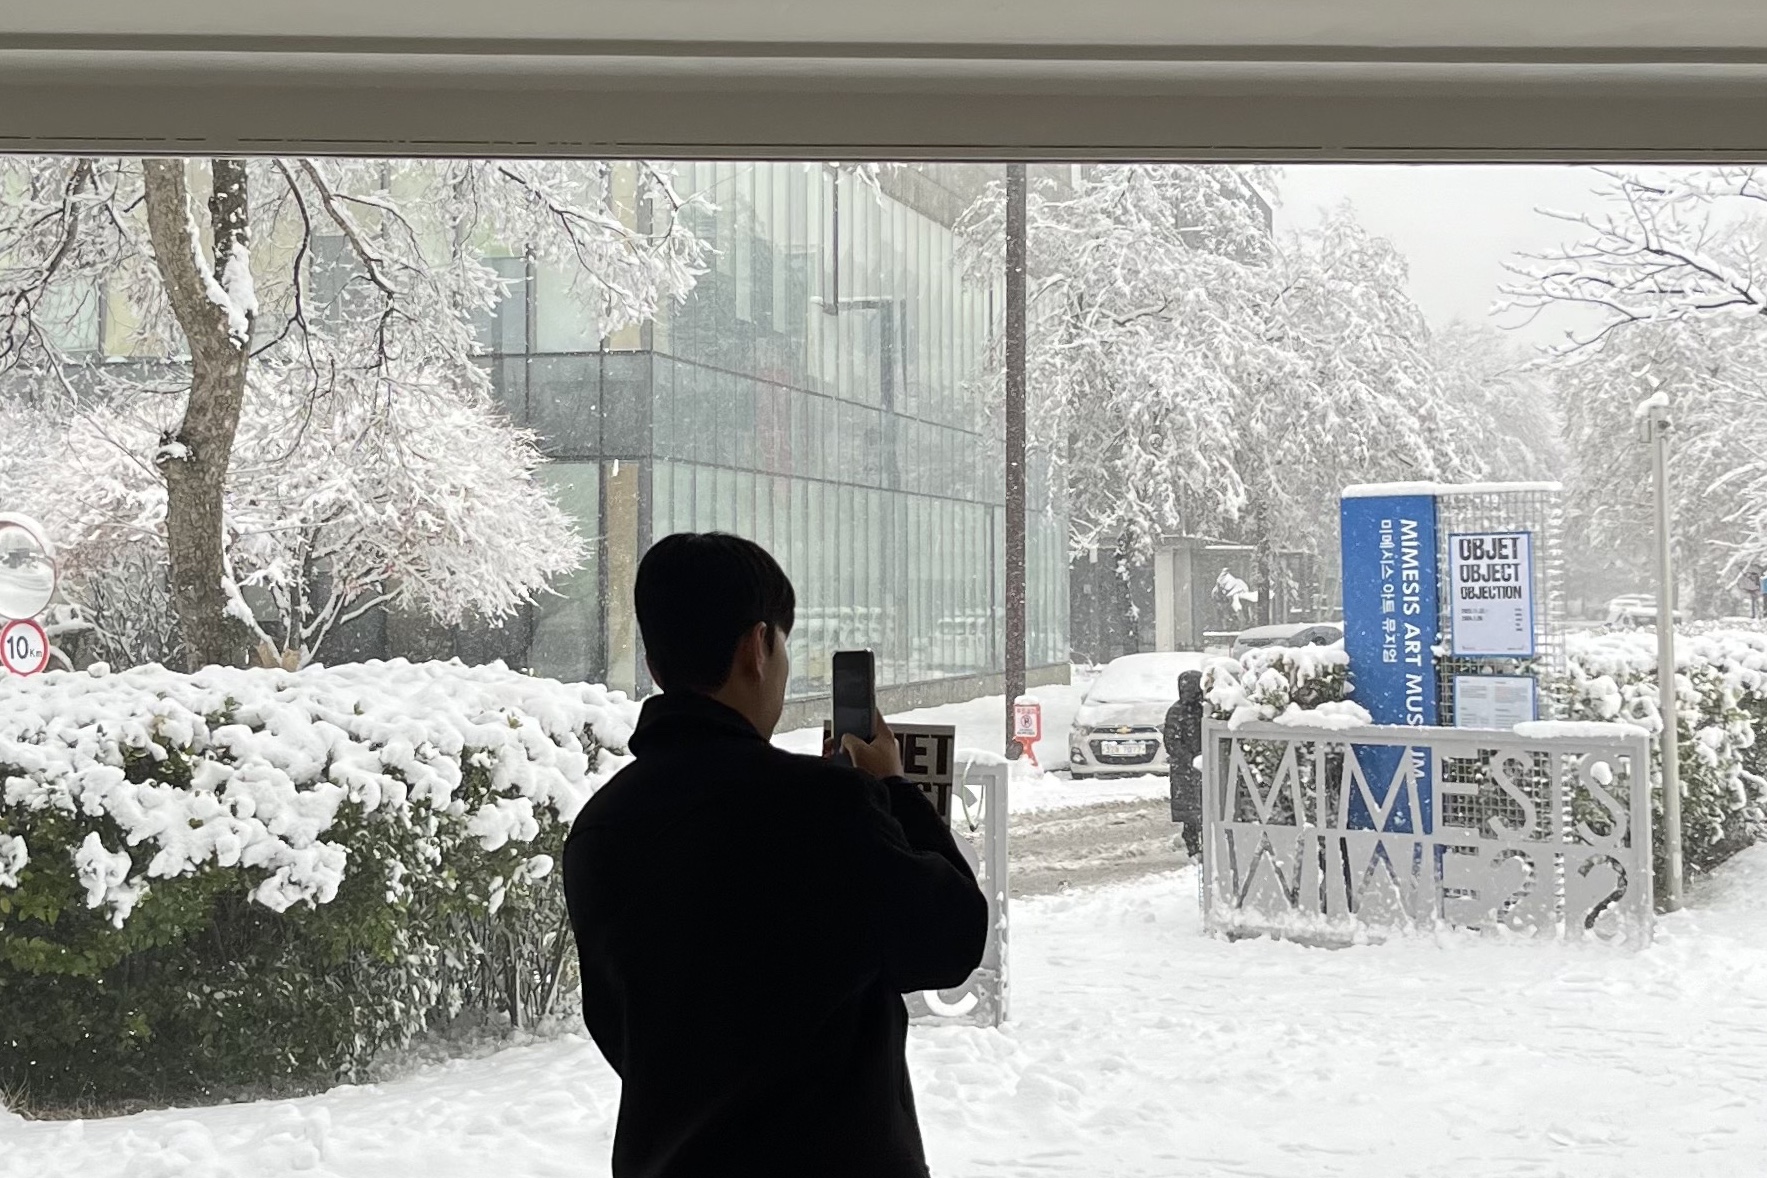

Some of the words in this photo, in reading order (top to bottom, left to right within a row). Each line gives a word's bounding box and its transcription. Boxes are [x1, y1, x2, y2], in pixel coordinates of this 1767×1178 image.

[1379, 519, 1395, 579] 미메시스
[1400, 519, 1420, 616] MIMESIS
[1459, 537, 1520, 561] OBJET
[1460, 563, 1521, 583] OBJECT
[1460, 585, 1522, 600] OBJECTION
[1381, 584, 1395, 613] 아트
[1382, 618, 1397, 662] 뮤지엄
[1404, 622, 1422, 667] ART
[1224, 737, 1628, 848] MIMESIS
